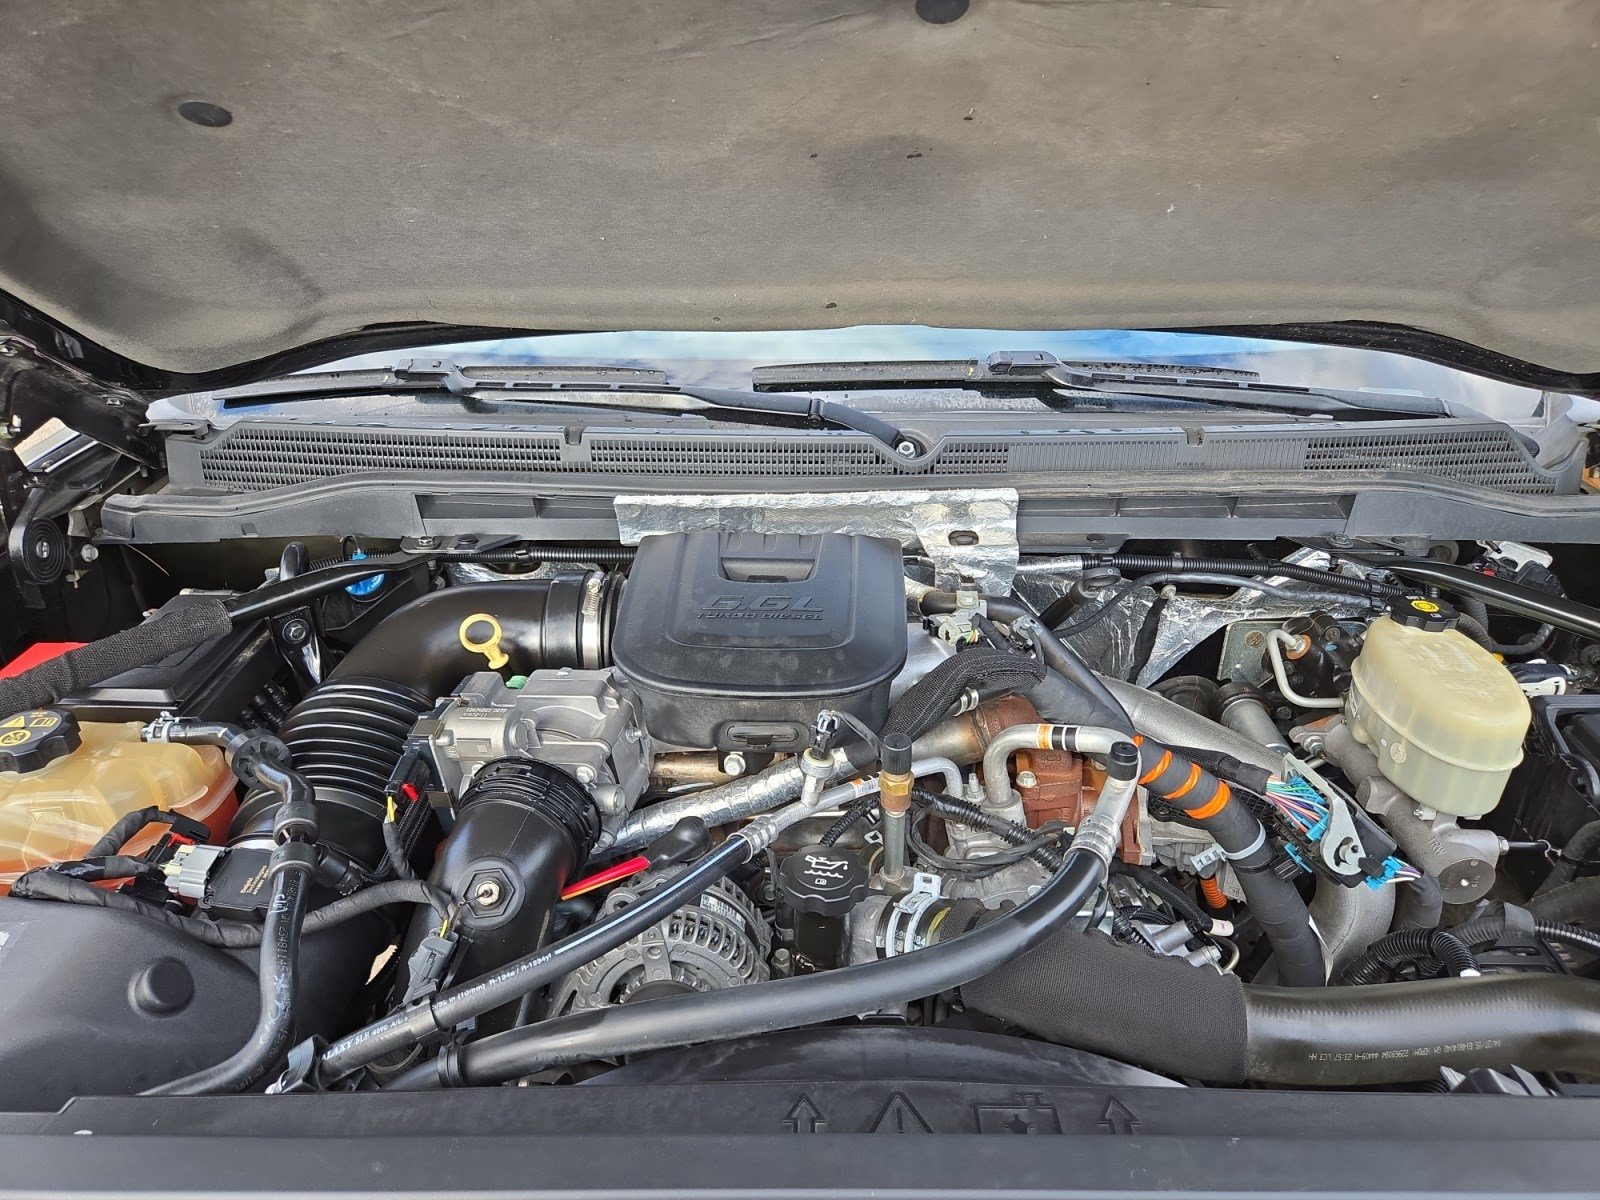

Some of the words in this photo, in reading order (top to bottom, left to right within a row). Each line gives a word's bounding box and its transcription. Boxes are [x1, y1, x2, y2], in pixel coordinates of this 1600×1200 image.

[701, 594, 824, 612] 6.6L
[697, 612, 758, 620] TURBO
[761, 612, 825, 621] DIESEL
[321, 1039, 353, 1060] ALAXY
